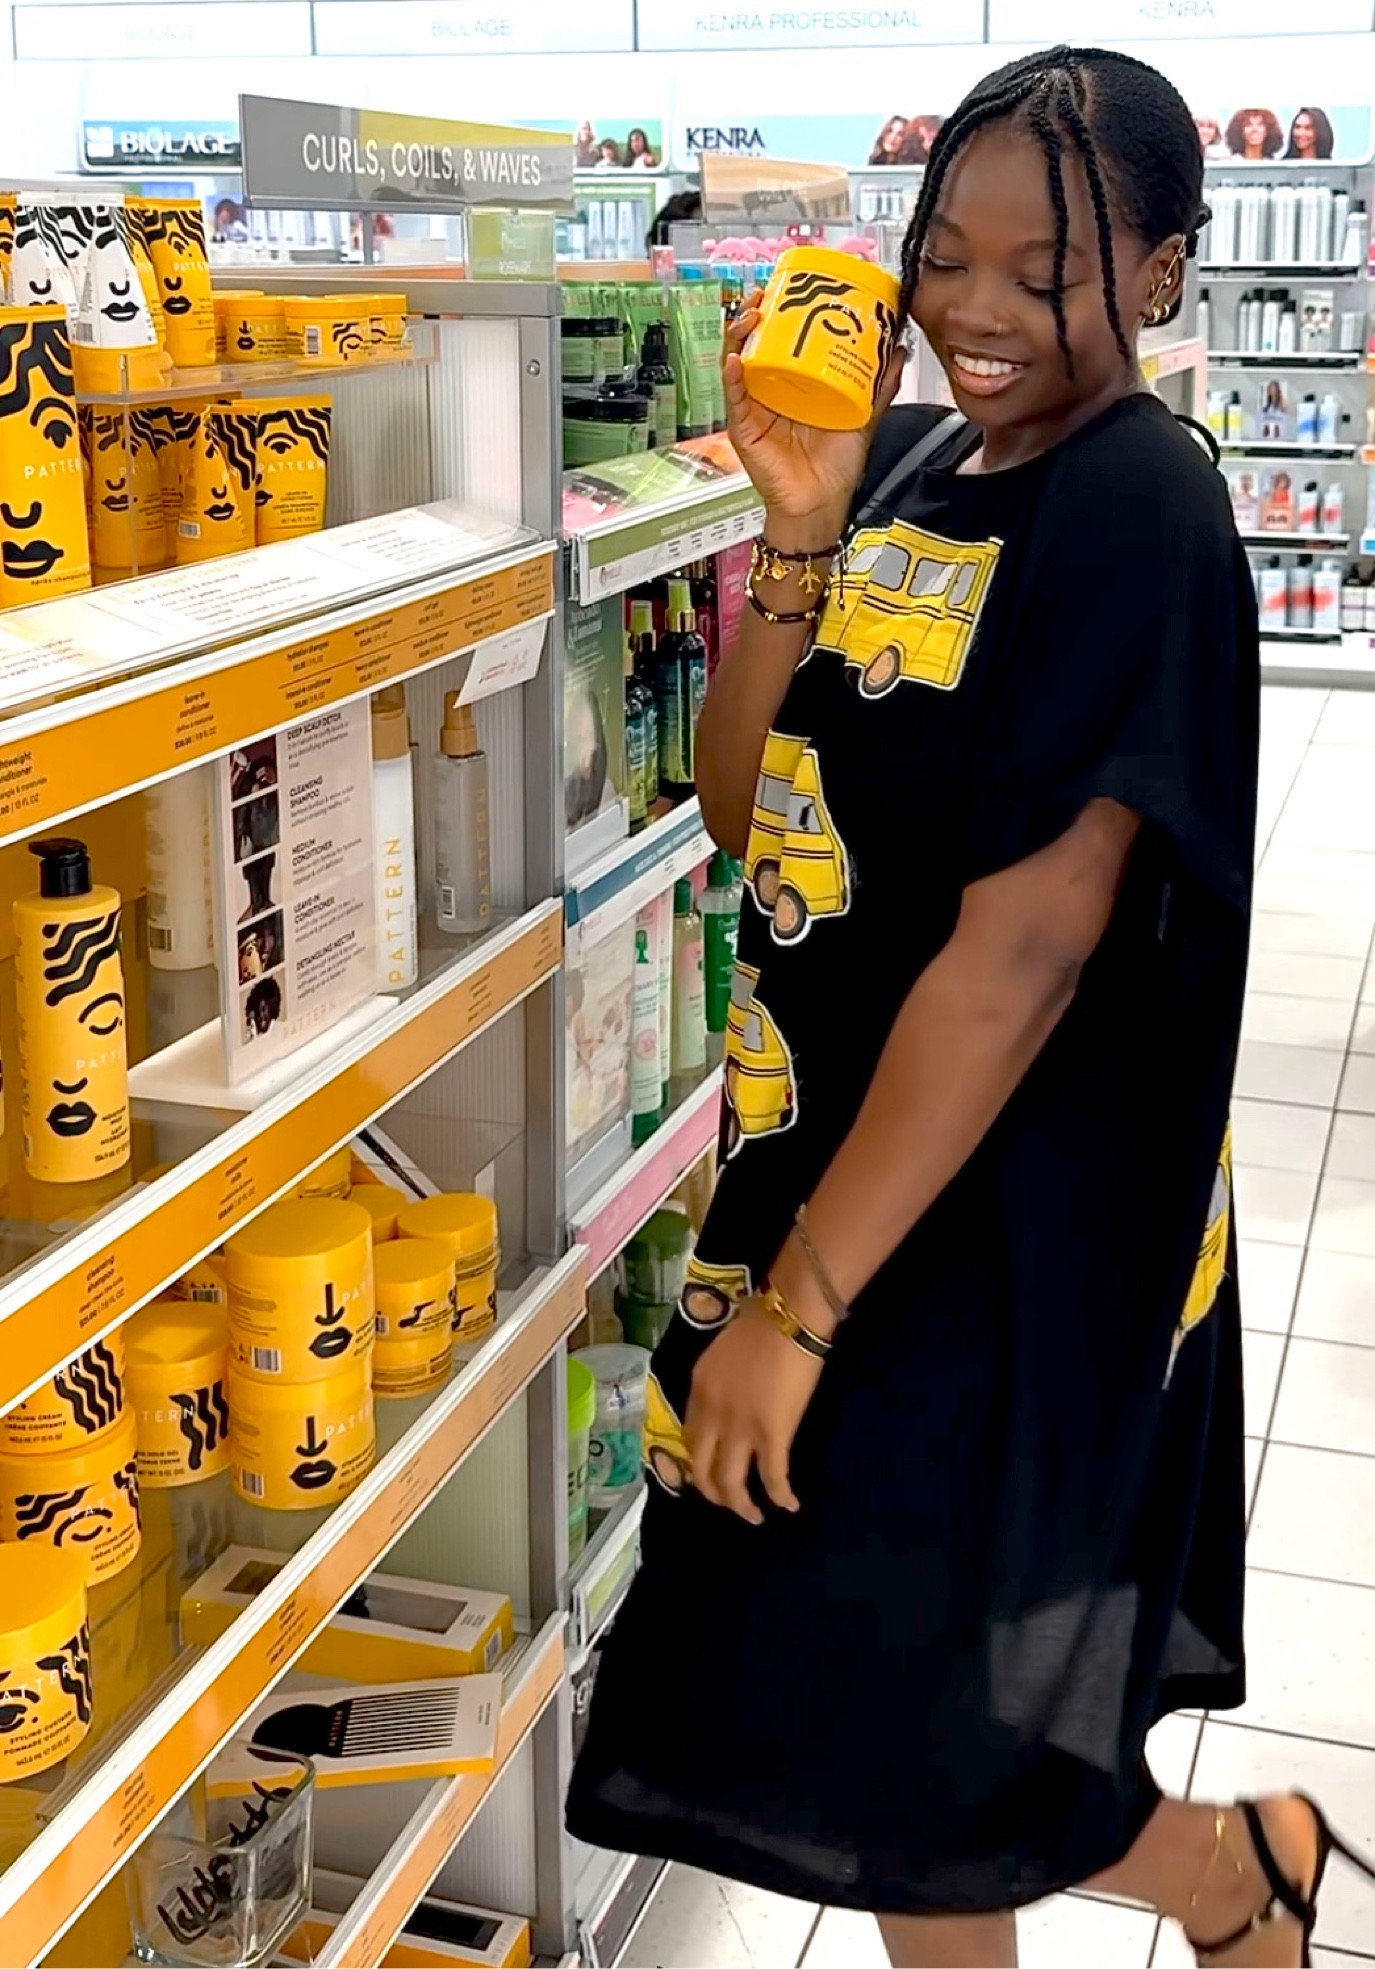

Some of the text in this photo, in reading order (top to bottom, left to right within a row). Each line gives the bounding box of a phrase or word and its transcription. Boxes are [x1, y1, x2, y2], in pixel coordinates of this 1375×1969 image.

[1137, 0, 1217, 19] KENRA
[431, 18, 512, 37] BIOLAGE
[695, 10, 923, 33] KENRA PROFESSIONAL
[120, 130, 235, 154] BIOLAGE
[686, 126, 766, 149] KENRA
[303, 132, 542, 188] CURLS, COILS, & WAVES
[256, 460, 325, 474] PATTERN
[289, 775, 323, 797] CLEANSING
[290, 788, 321, 809] SHAMPOO
[292, 840, 333, 867] CONDITIONER
[295, 895, 335, 925] CONDITIONER
[385, 837, 405, 984] PATTERN
[10, 1729, 42, 1745] STYLING
